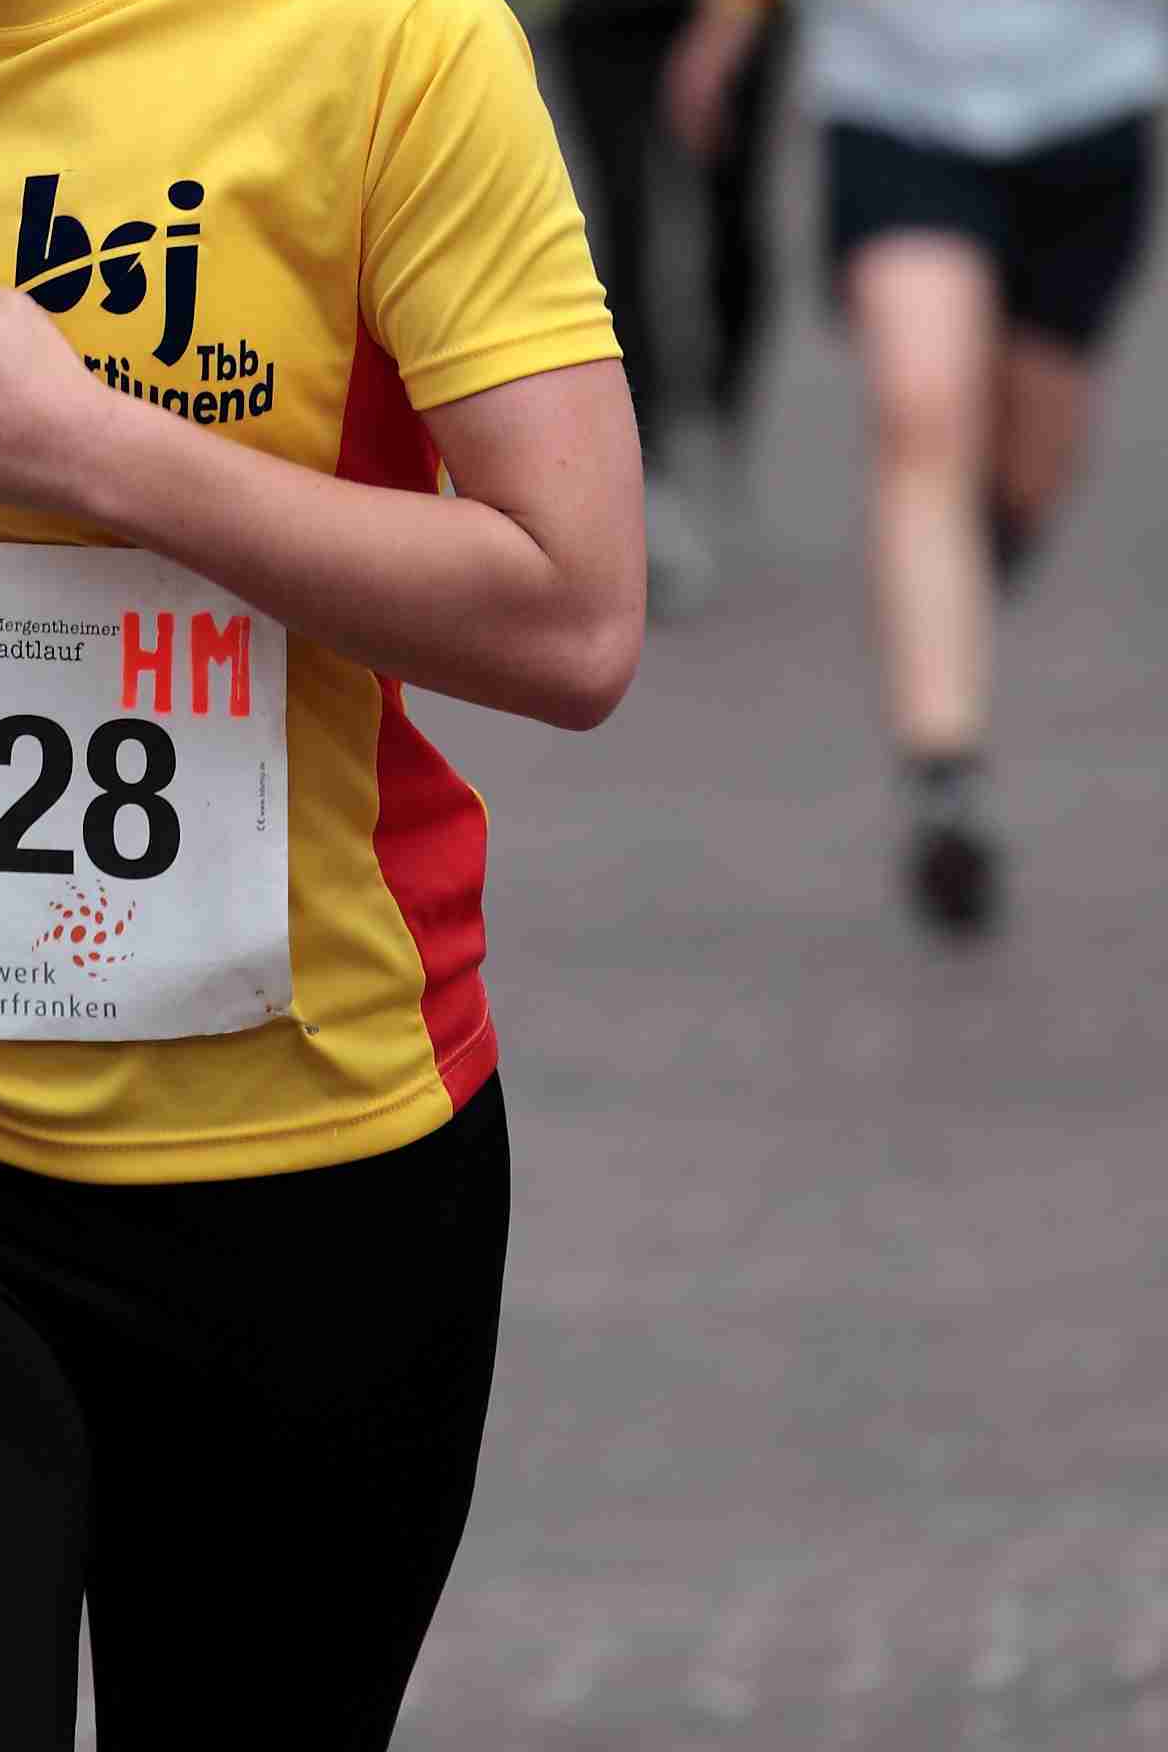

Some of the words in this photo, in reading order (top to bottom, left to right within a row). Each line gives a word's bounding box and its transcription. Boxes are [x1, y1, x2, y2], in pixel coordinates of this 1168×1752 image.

[15, 174, 205, 367] bsj
[196, 339, 259, 382] Tbb
[122, 610, 252, 717] HM
